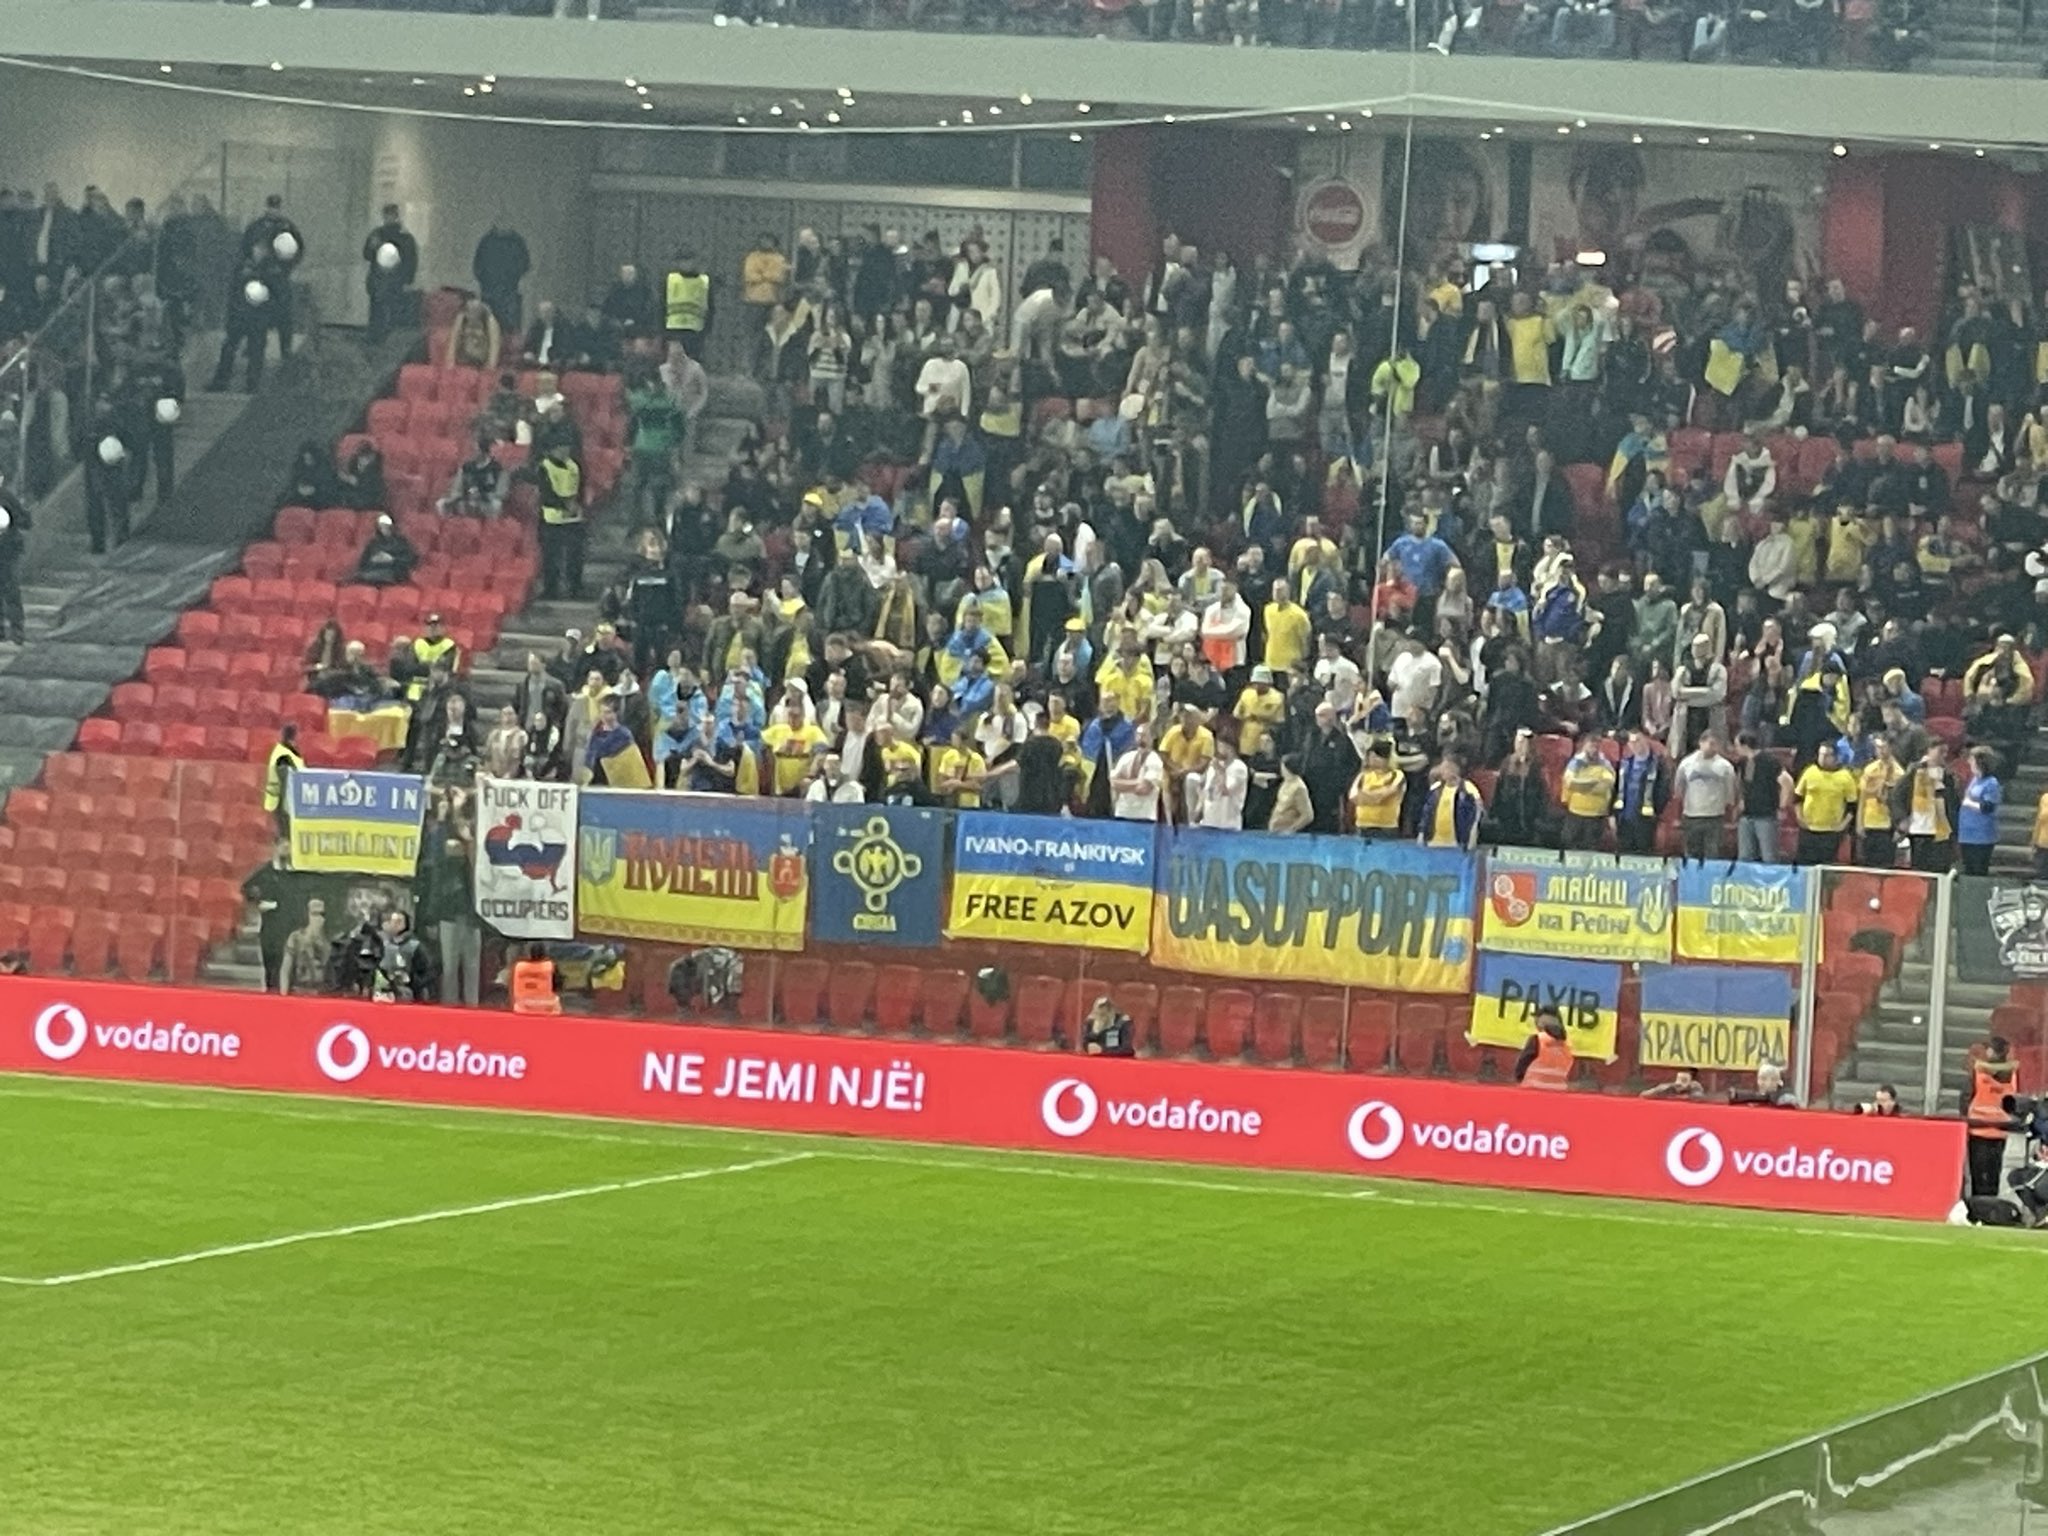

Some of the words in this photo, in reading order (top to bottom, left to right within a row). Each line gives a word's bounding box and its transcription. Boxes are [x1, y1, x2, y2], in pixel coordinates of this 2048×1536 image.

[301, 780, 378, 808] MADE
[391, 787, 418, 811] IN
[482, 786, 529, 808] FUCK
[538, 788, 571, 811] OFF
[964, 836, 1146, 866] IVANO-FRANKIVSK
[481, 897, 570, 922] OCCUPIERS
[966, 894, 1038, 922] FREE
[1045, 899, 1135, 930] AZOV
[1168, 853, 1459, 960] UASUPPORT
[1498, 979, 1602, 1030] РАХІВ
[95, 1022, 241, 1058] vodafone
[1641, 1019, 1786, 1067] КРАСНОГРАД
[378, 1043, 527, 1080] vodafone
[642, 1051, 704, 1096] NE
[713, 1056, 815, 1105] JEMI
[829, 1059, 926, 1113] NJË!
[1106, 1098, 1262, 1138] vodafone
[1411, 1121, 1570, 1161] vodafone
[1733, 1147, 1895, 1187] vodafone
